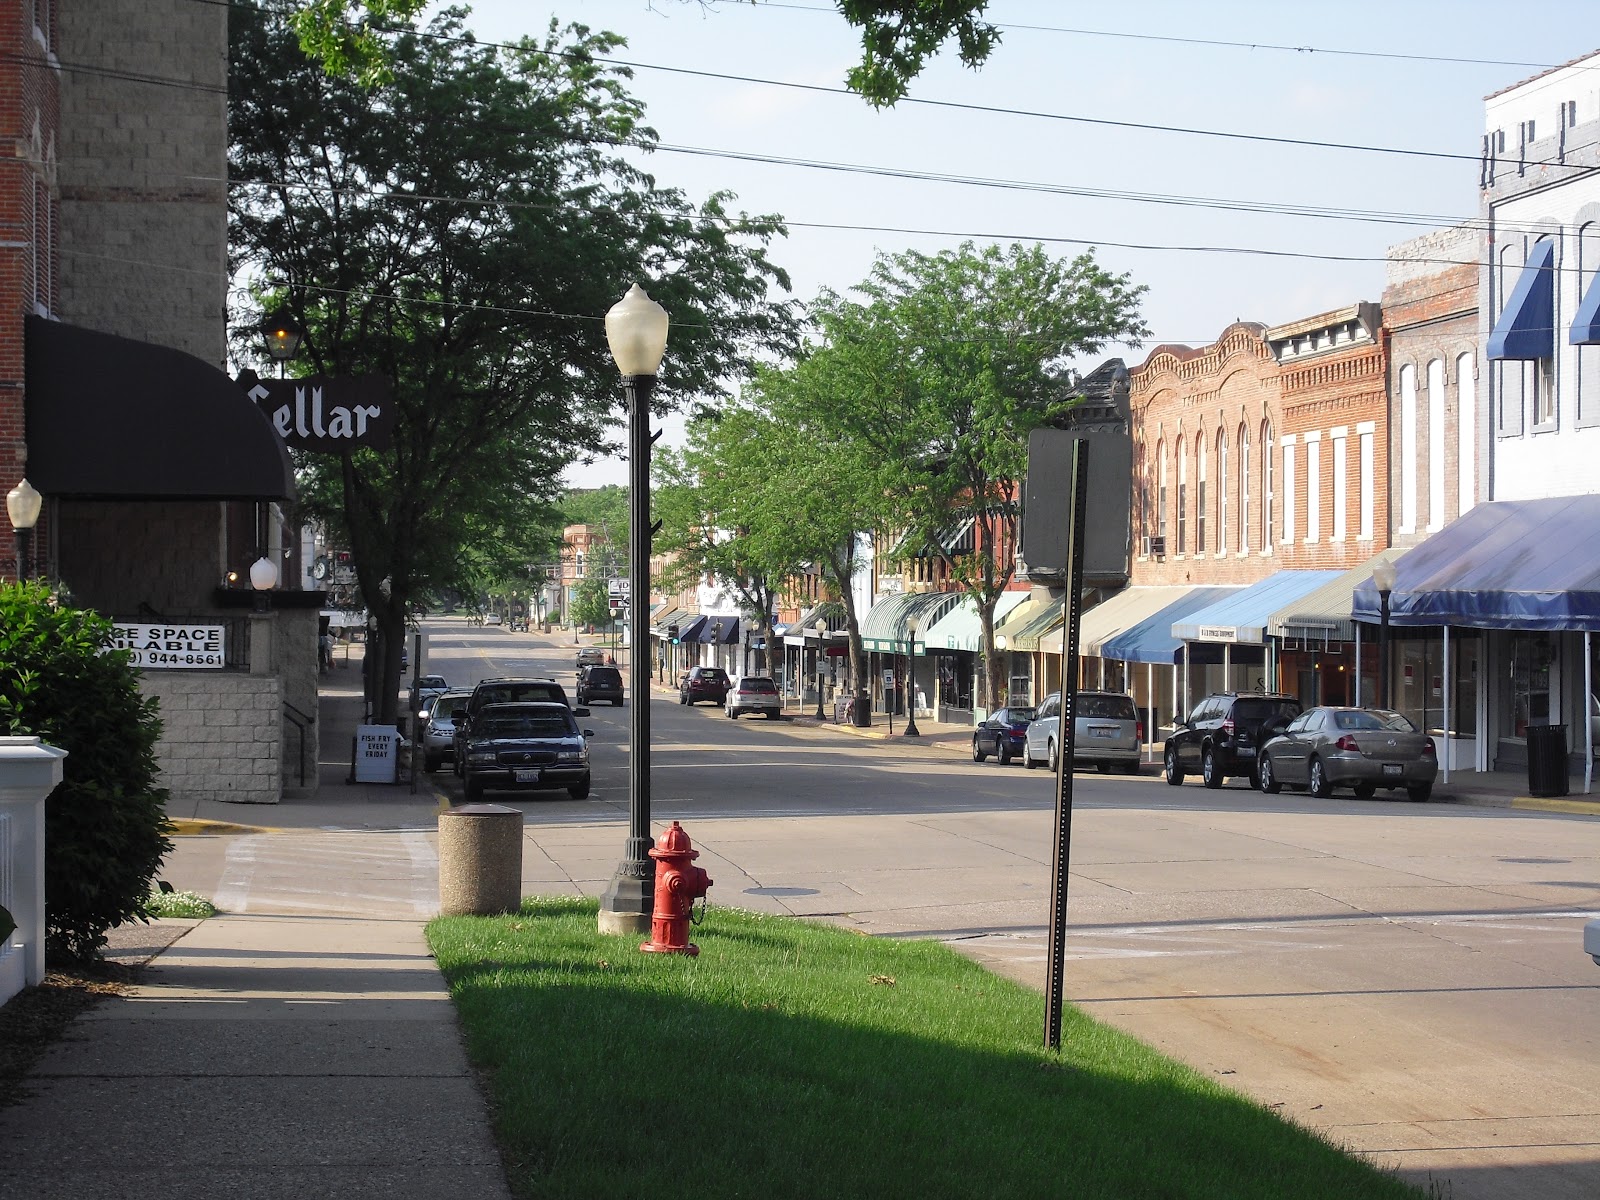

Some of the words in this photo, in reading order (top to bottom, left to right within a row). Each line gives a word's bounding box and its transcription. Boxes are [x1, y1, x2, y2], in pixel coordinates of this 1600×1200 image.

[148, 628, 220, 640] SPACE
[101, 640, 220, 652] AILABLE
[149, 652, 222, 665] 944-8561
[365, 750, 388, 758] FRIDAY
